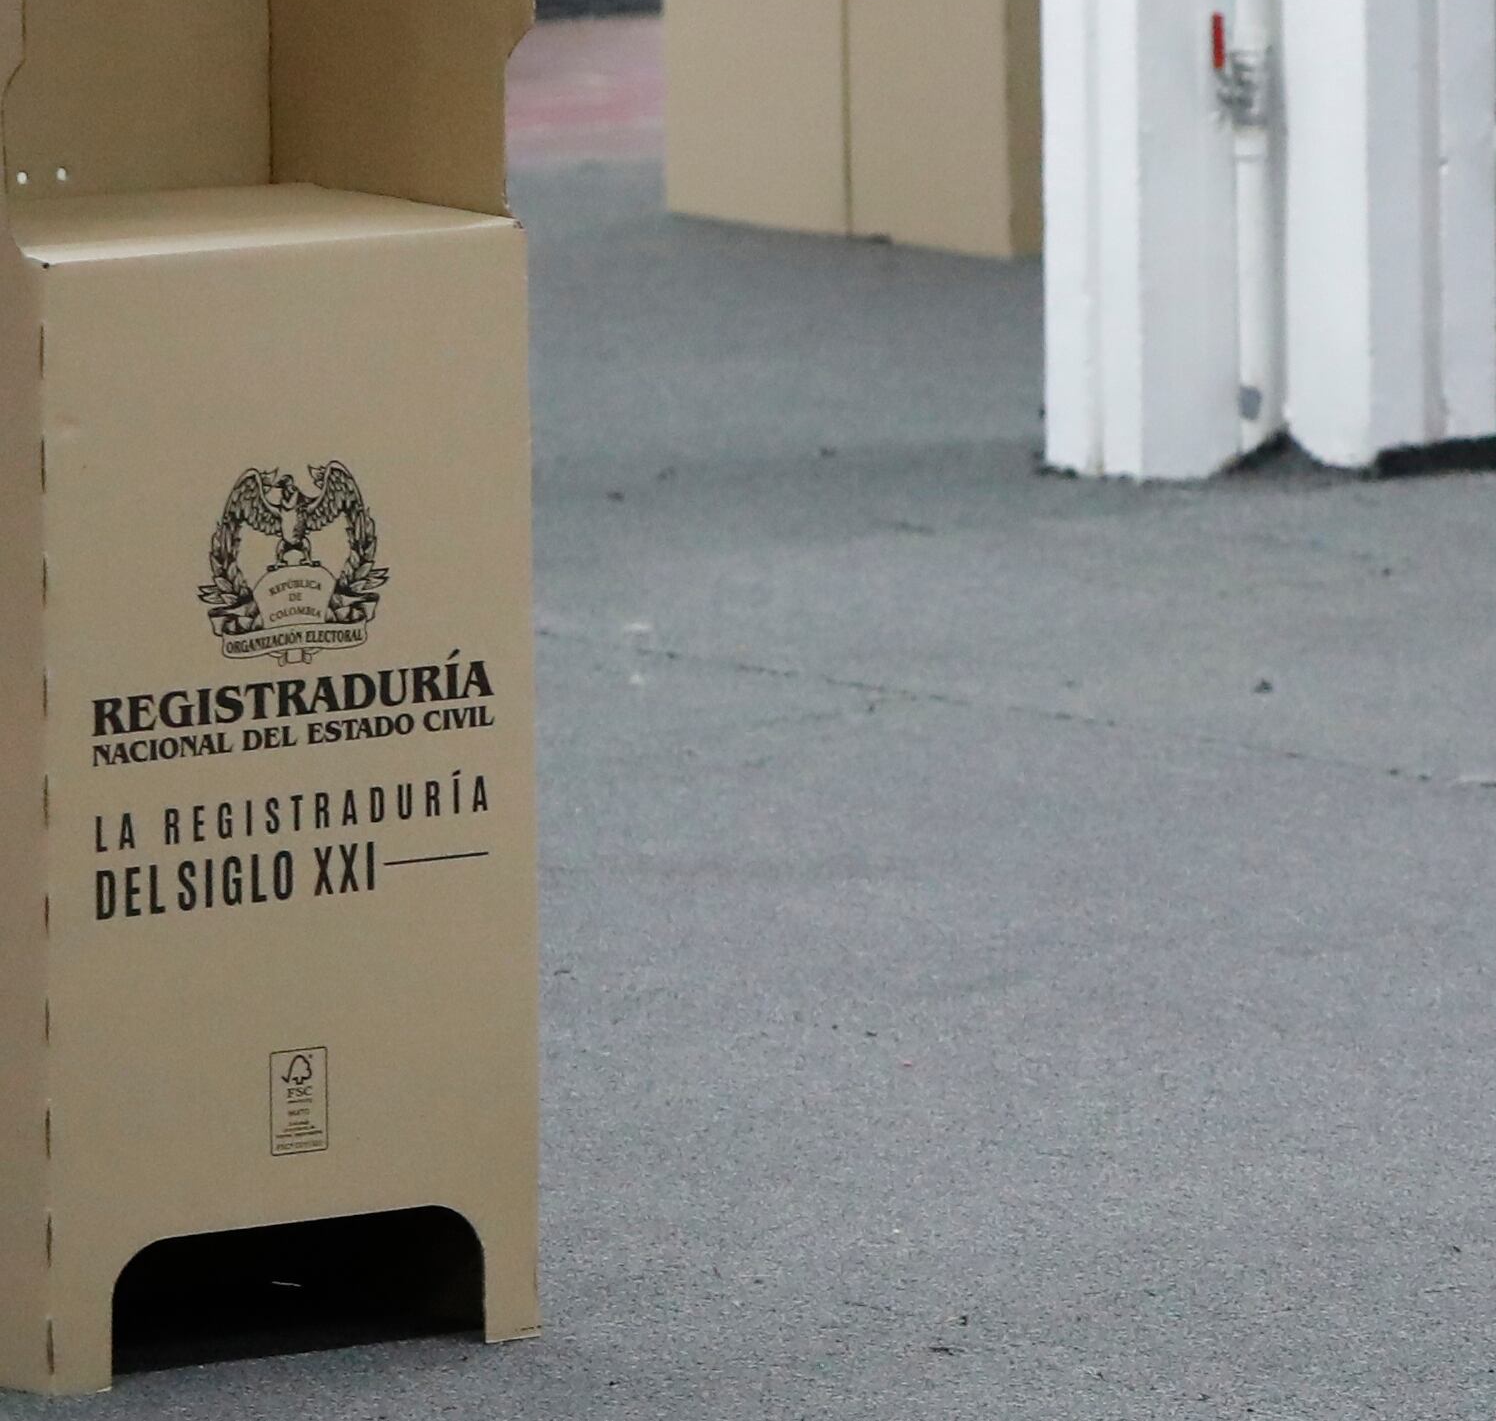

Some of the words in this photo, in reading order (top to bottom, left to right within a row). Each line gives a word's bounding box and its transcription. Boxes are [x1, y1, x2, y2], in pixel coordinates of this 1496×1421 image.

[269, 578, 322, 597] REPÚBLICA
[289, 592, 302, 601] DE
[269, 606, 322, 623] COLOMBIA
[226, 628, 303, 654] ORGANIZACIÓN
[305, 629, 362, 644] ELECTORAL
[92, 648, 494, 736] REGISTRADURÍA
[92, 732, 233, 767] NACIONAL
[242, 725, 297, 750] DEL
[307, 712, 414, 744] ESTADO
[423, 706, 494, 732] CIVIL
[96, 812, 135, 853] LA
[164, 769, 488, 845] REGISTRADURÍA
[314, 841, 375, 896] XXI
[287, 1085, 312, 1098] FSC
